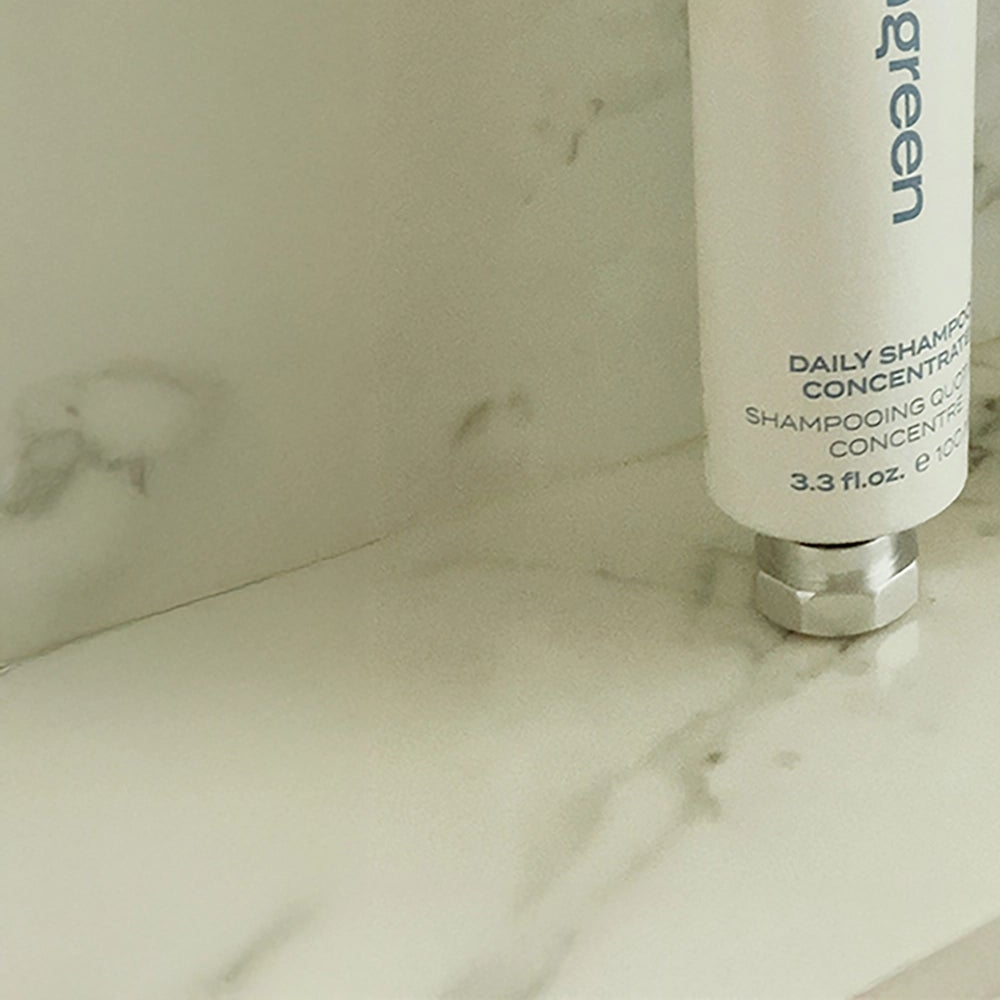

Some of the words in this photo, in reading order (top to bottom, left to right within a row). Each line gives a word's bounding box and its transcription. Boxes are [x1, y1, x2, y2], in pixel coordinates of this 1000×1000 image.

[875, 11, 924, 225] green
[789, 350, 872, 373] DAILY
[745, 397, 926, 432] SHAMPOOING
[790, 472, 835, 492] 3.3
[841, 466, 906, 490] fl.oz.
